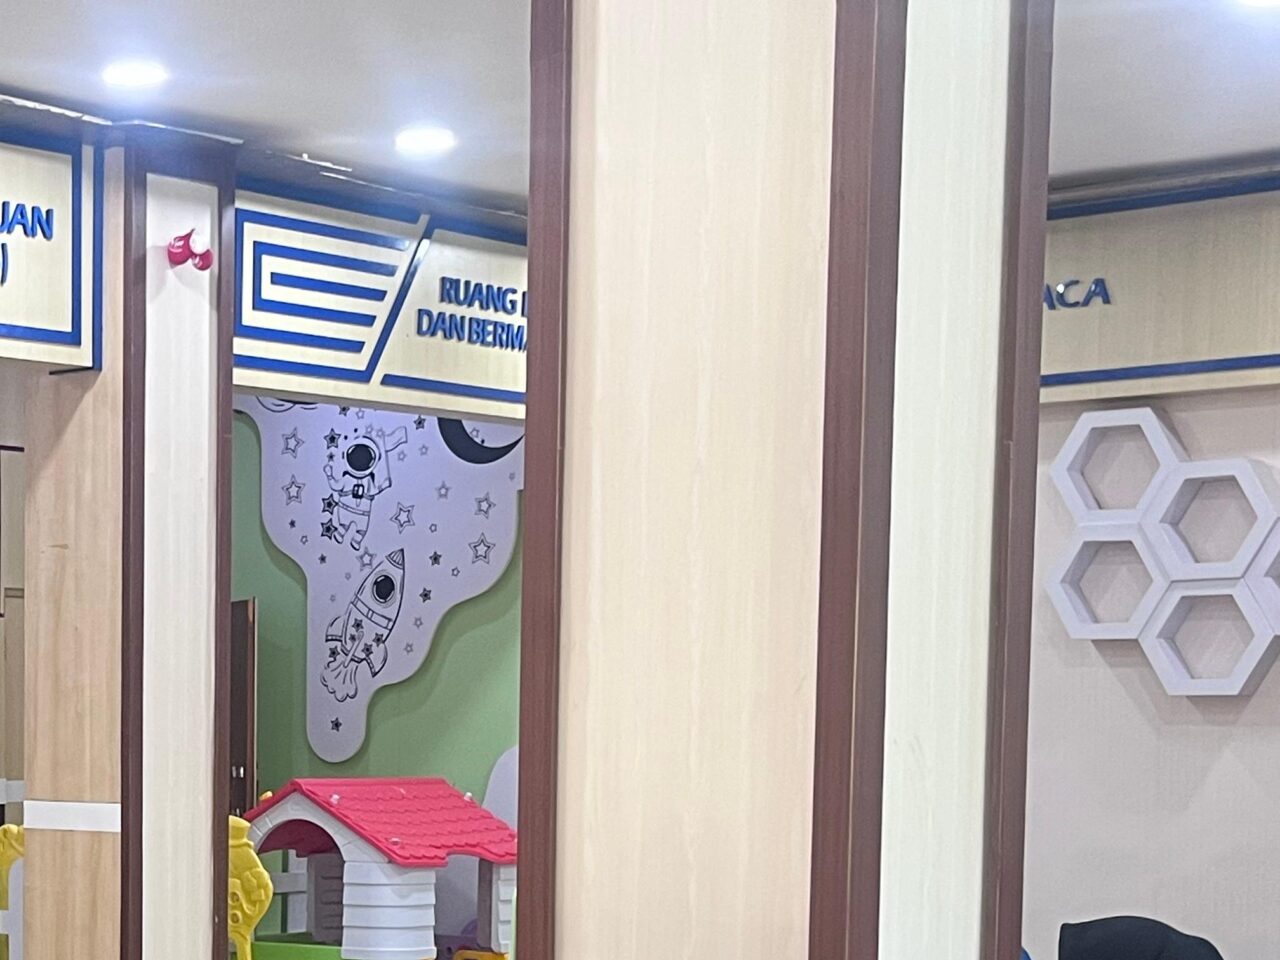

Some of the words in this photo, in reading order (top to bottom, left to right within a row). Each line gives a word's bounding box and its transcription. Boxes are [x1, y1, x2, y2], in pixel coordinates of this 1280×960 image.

[439, 276, 517, 315] RUANG
[416, 308, 466, 342] DAN
[467, 316, 527, 353] BERM
